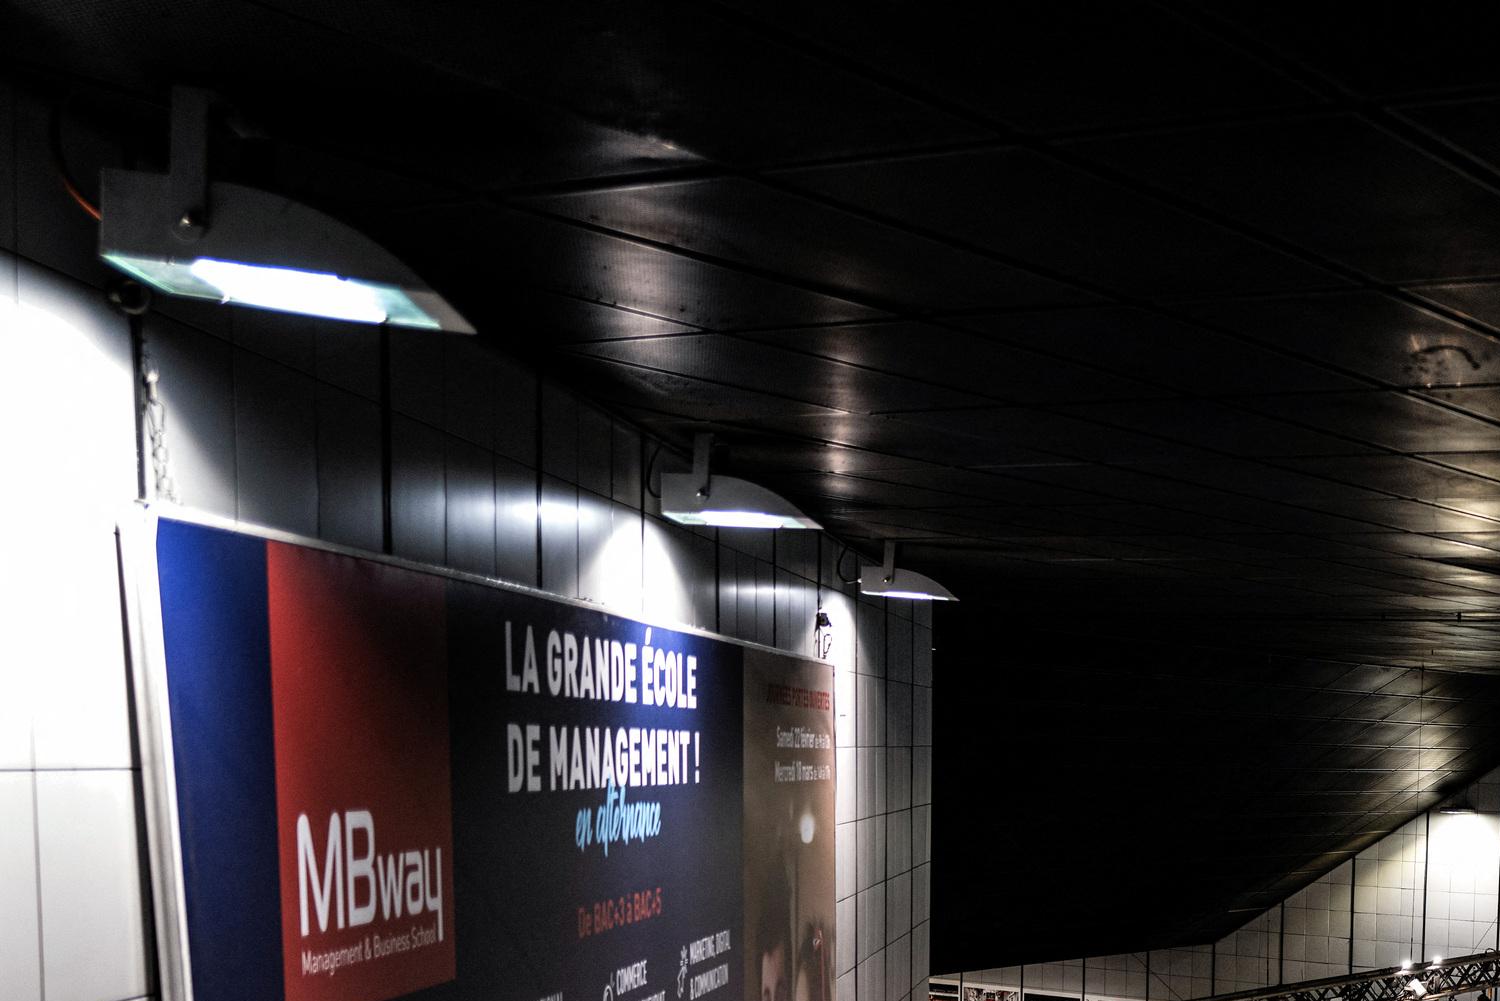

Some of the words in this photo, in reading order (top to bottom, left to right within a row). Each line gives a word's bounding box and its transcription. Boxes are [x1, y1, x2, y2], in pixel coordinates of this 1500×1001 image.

[505, 620, 540, 694] LA
[547, 629, 637, 704] GRANDE
[641, 627, 697, 709] ÉCOLE
[507, 723, 541, 792] DE
[549, 725, 690, 791] MANAGEMENT
[694, 731, 700, 784] !
[575, 807, 593, 852] en
[596, 776, 661, 858] alternance
[296, 810, 443, 942] MBway
[577, 906, 592, 938] De
[594, 897, 625, 934] BAC+3
[634, 887, 662, 922] BAC+5
[302, 940, 363, 976] Management
[364, 937, 372, 960] &
[373, 932, 410, 959] Business
[411, 922, 437, 949] School
[616, 959, 647, 996] COMMERCE
